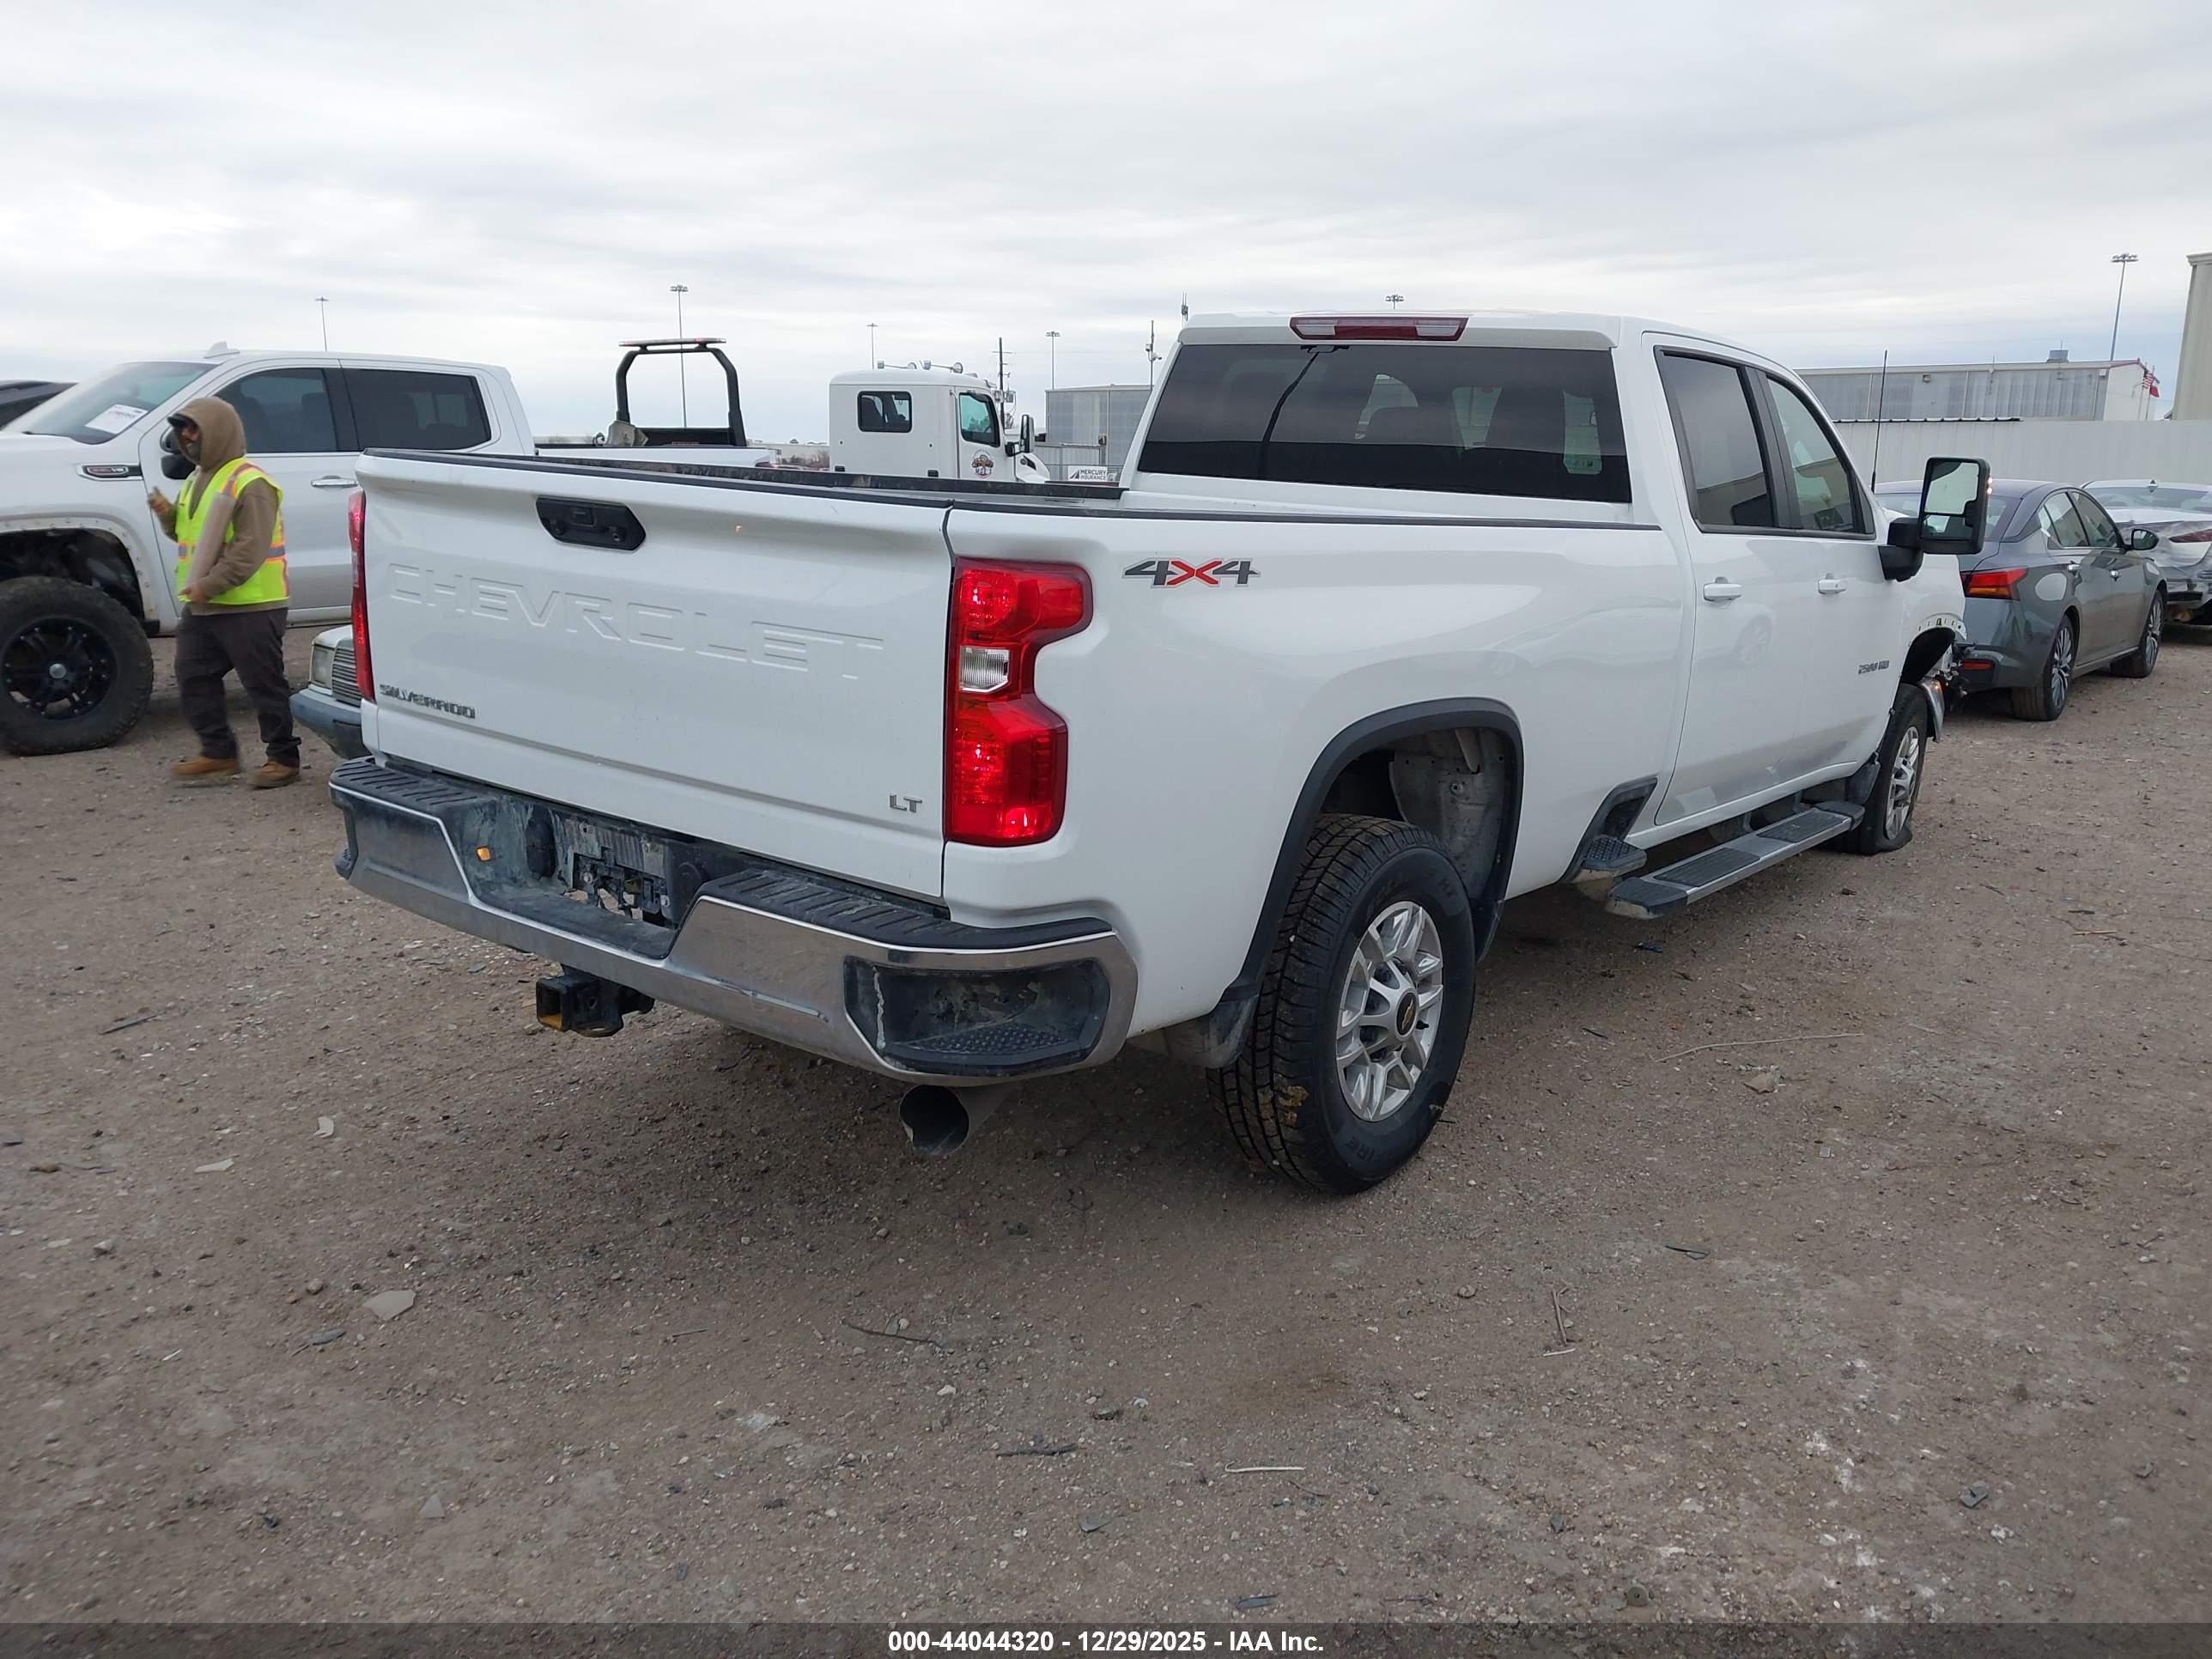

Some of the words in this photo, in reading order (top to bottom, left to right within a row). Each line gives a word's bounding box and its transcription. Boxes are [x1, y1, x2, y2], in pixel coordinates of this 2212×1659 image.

[390, 562, 884, 680] CHEVROLET
[379, 684, 476, 719] SILVERADO
[889, 793, 923, 813] LT
